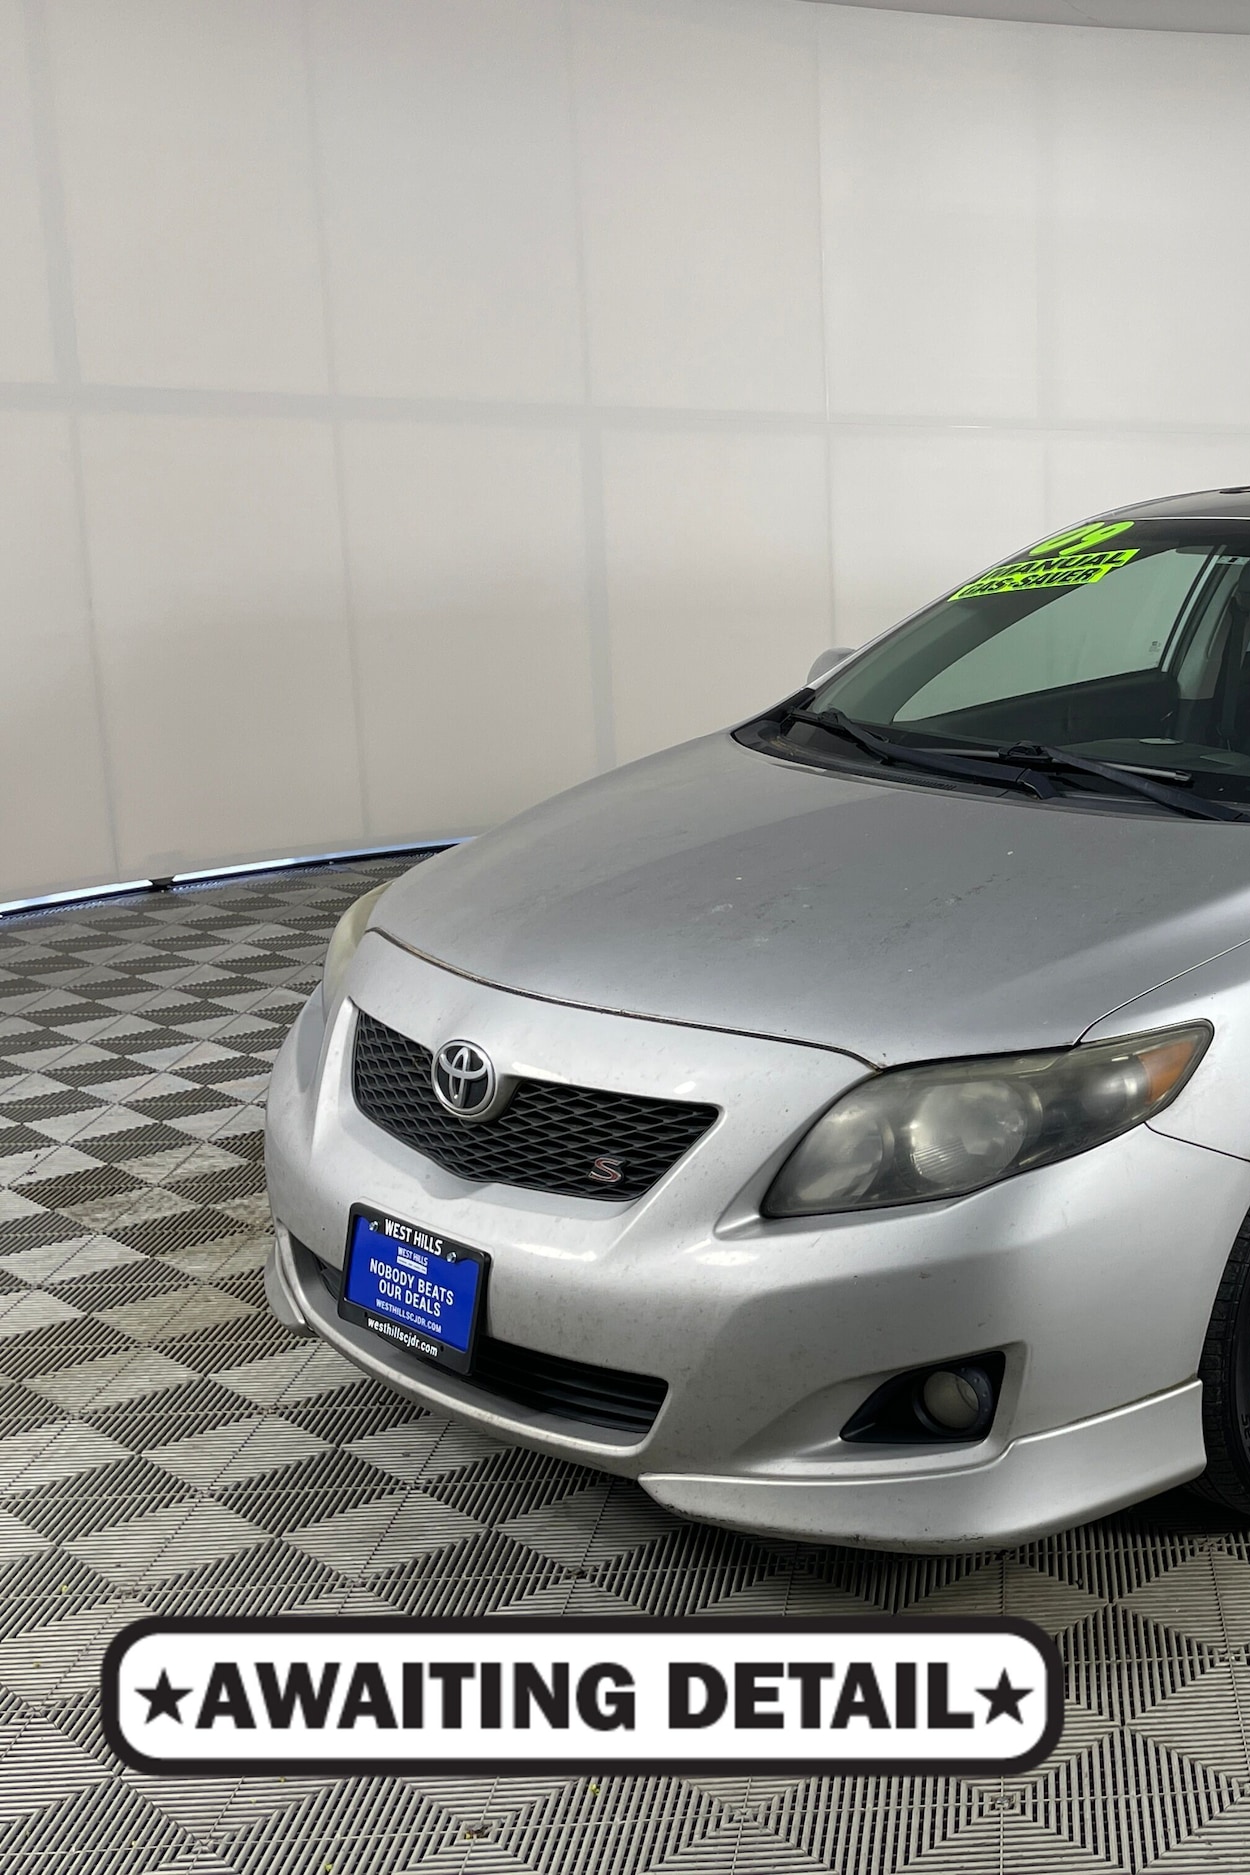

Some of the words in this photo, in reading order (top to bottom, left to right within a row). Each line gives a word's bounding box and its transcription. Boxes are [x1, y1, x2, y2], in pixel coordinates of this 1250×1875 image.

[1029, 521, 1135, 557] 09
[982, 551, 1125, 582] MANUAL
[588, 1157, 623, 1183] S
[384, 1218, 412, 1243] WEST
[413, 1231, 443, 1256] HILLS
[398, 1246, 413, 1260] WEST
[413, 1253, 428, 1266] HILLS
[369, 1258, 415, 1289] NOBODY
[418, 1278, 454, 1306] BEATS
[379, 1279, 402, 1301] OUR
[405, 1290, 441, 1317] DEALS
[376, 1298, 442, 1334] WESTHILLSCJDR.COM
[368, 1317, 438, 1357] westhillscjdr.com
